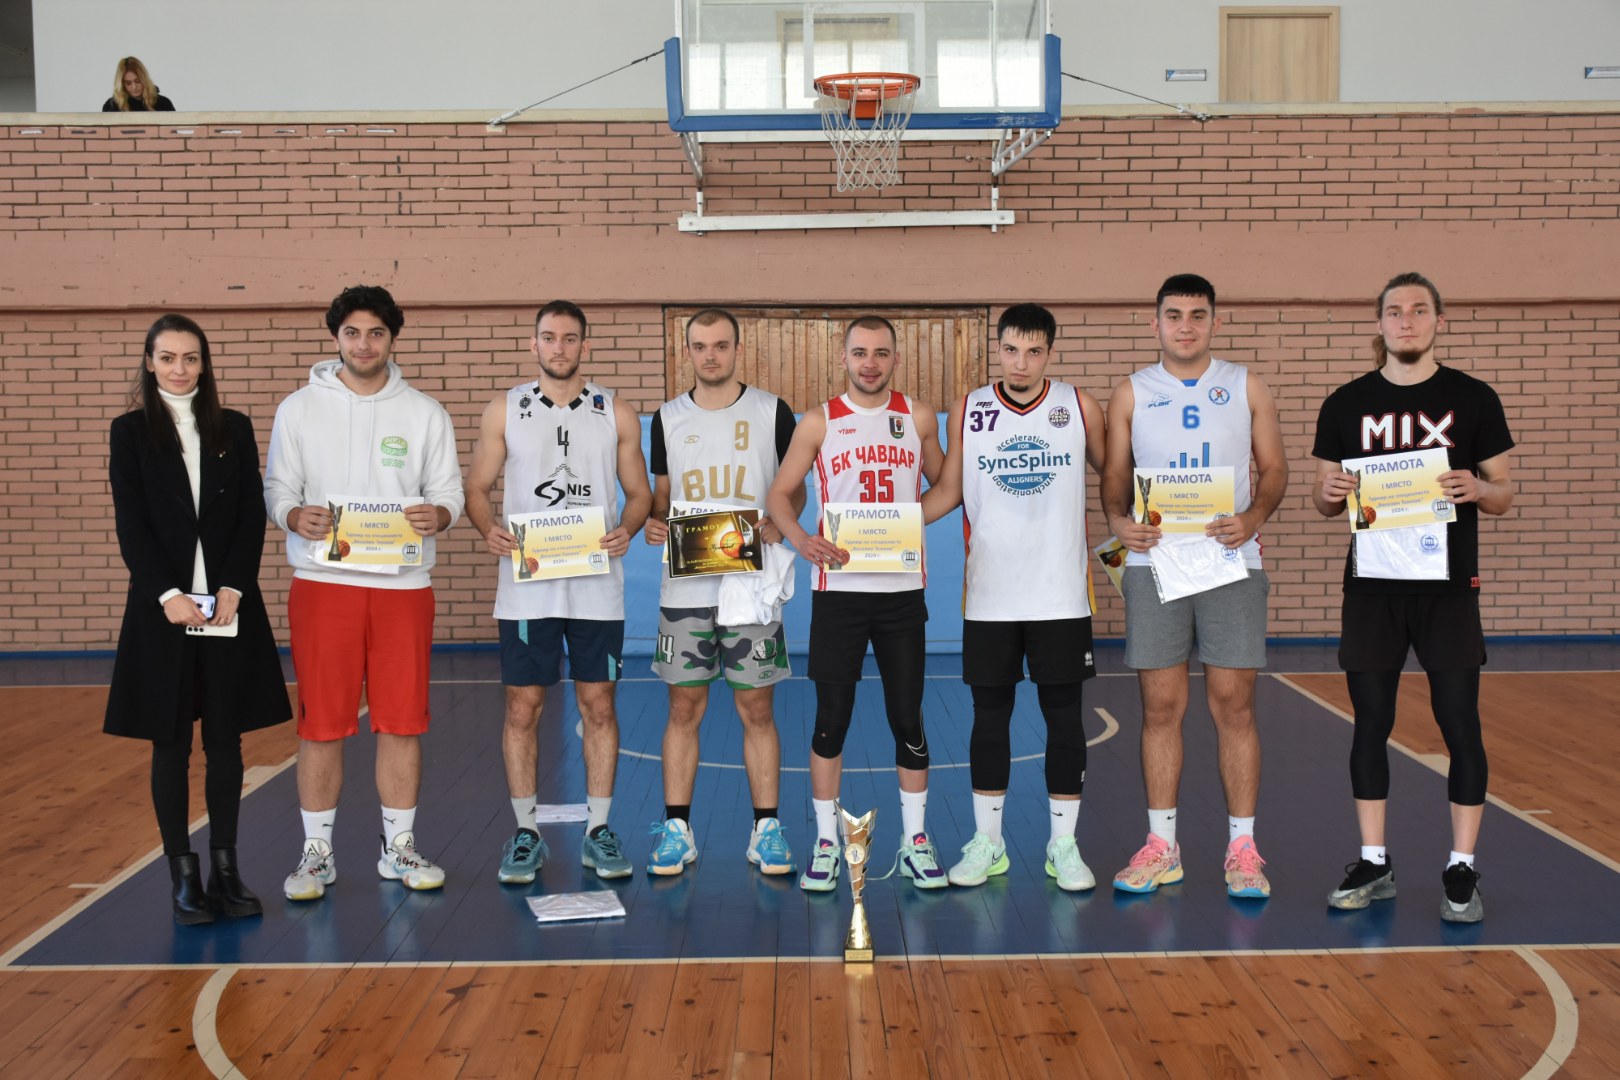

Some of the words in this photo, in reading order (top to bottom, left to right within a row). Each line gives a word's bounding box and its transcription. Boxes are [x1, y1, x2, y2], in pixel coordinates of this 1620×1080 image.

[970, 410, 1000, 432] 37
[1182, 405, 1200, 429] 6
[735, 420, 749, 451] 9
[1361, 410, 1454, 451] MIX
[557, 425, 569, 456] 4
[996, 434, 1050, 452] acceleration
[831, 450, 851, 476] БК
[855, 444, 914, 469] ЧАВДАР
[978, 452, 1072, 474] SyncSplint
[1365, 458, 1424, 474] ГРАМОТА
[682, 464, 756, 502] BUL
[860, 469, 894, 503] 35
[992, 472, 1057, 498] synchronization
[1008, 476, 1043, 484] ALIGNERS
[1156, 474, 1212, 484] ГРАМОТА
[1386, 481, 1412, 489] МЯСТО
[567, 483, 591, 496] NIS
[348, 502, 403, 513] ГРАМОТА
[846, 510, 900, 519] ГРАМОТА
[530, 514, 584, 528] ГРАМОТА
[686, 524, 721, 533] ГРАМОТ
[549, 534, 572, 542] МЯСТО
